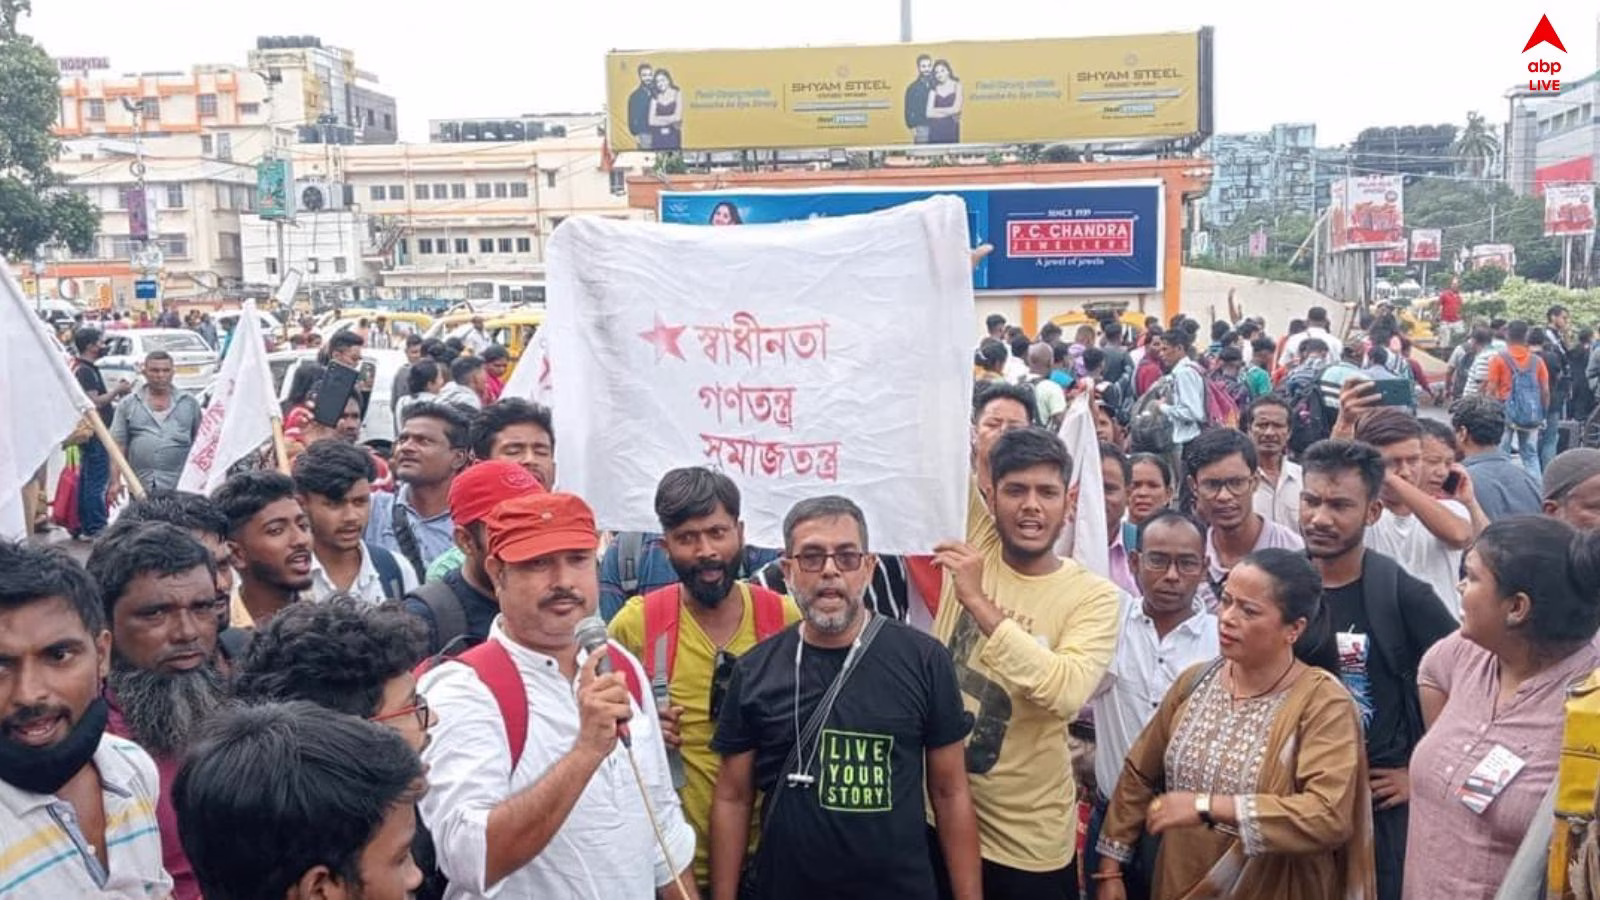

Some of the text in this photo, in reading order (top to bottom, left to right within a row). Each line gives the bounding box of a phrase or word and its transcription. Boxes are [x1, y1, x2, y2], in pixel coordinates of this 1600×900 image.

[60, 56, 109, 70] HOSPITAL
[1076, 67, 1183, 82] SHYAM STEEL
[791, 79, 891, 93] SHYAM STEEL
[1047, 209, 1072, 217] SINCE
[1049, 223, 1128, 237] CHANDRA
[1012, 240, 1128, 250] JEWELLERS
[1035, 258, 1043, 267] A
[693, 311, 830, 366] স্বাধীনতা
[698, 381, 798, 429] গণতন্ত্র
[699, 433, 843, 482] সমাজতন্ত্র
[830, 736, 885, 762] LIVE
[829, 763, 884, 785] YOUR
[827, 785, 884, 805] STORY
